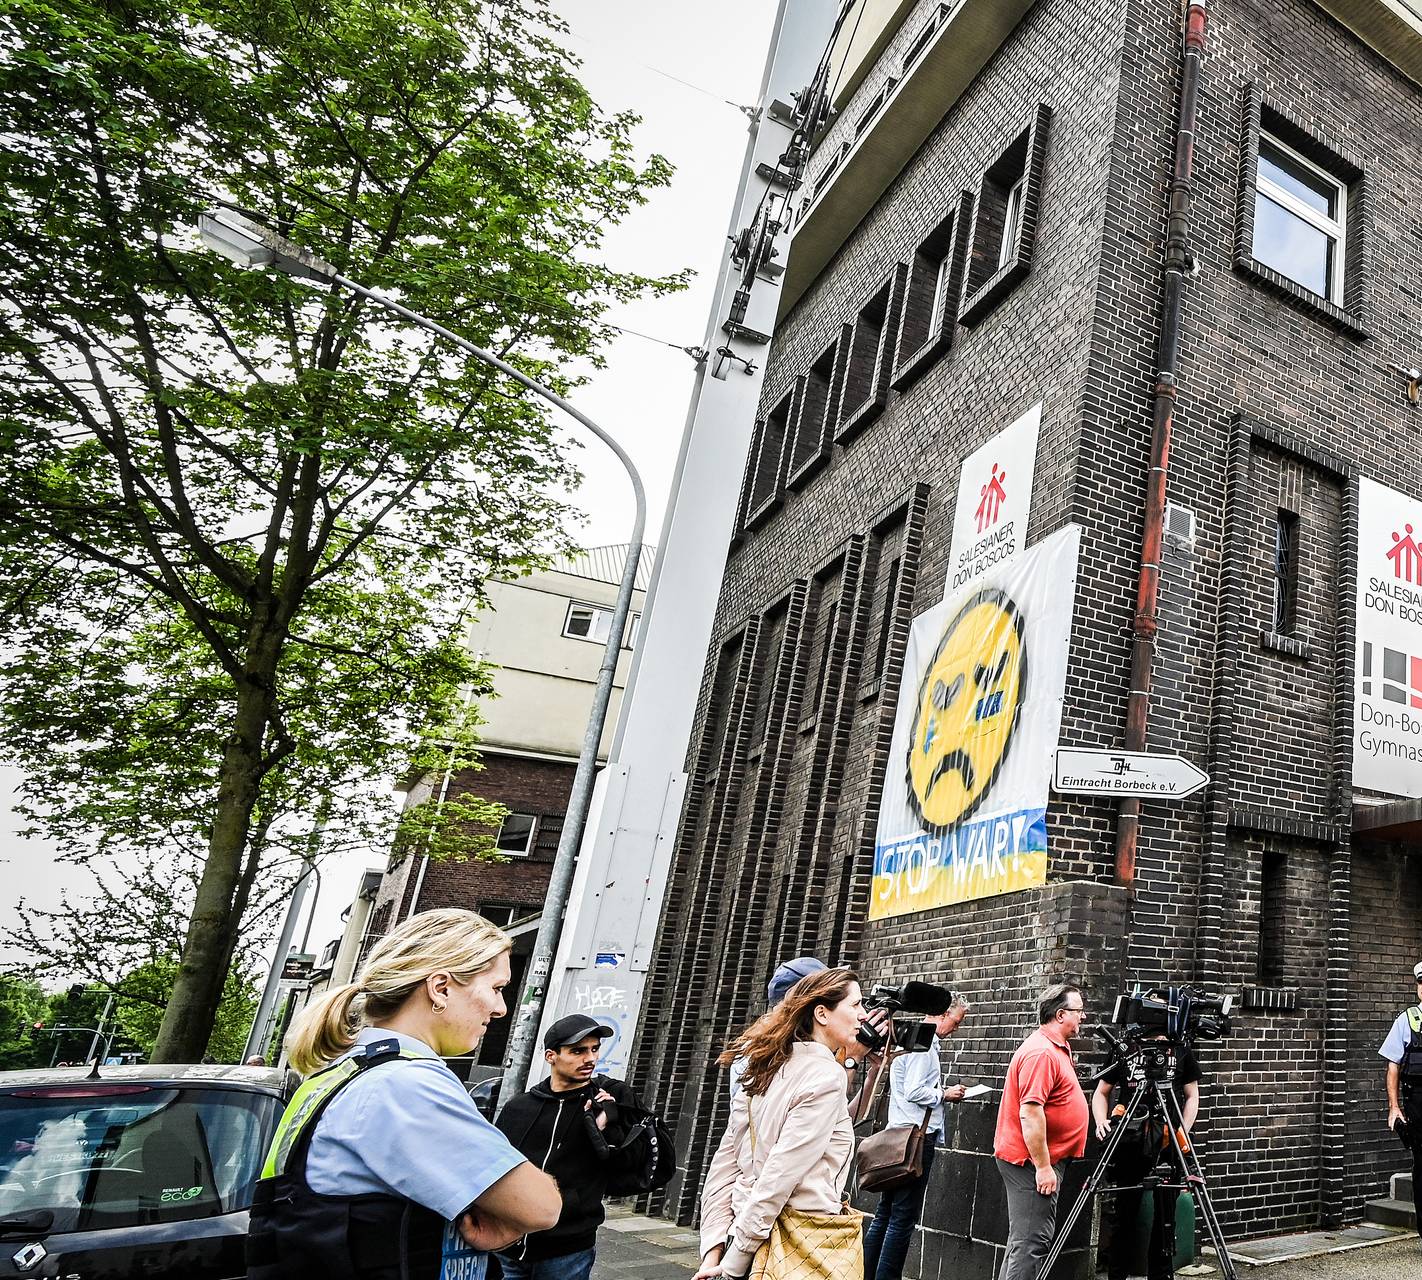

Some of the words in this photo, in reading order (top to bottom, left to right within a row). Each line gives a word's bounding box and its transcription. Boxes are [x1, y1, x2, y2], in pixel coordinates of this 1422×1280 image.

[952, 564, 974, 589] DON
[975, 538, 1016, 576] BOSCOS
[958, 521, 1014, 569] SALESIANER
[1365, 592, 1394, 616] DON
[1061, 776, 1111, 788] Eintracht
[1114, 779, 1157, 791] Borbeck
[1159, 781, 1177, 791] e.V.
[879, 838, 942, 900] STOP
[952, 815, 1026, 885] WAR!
